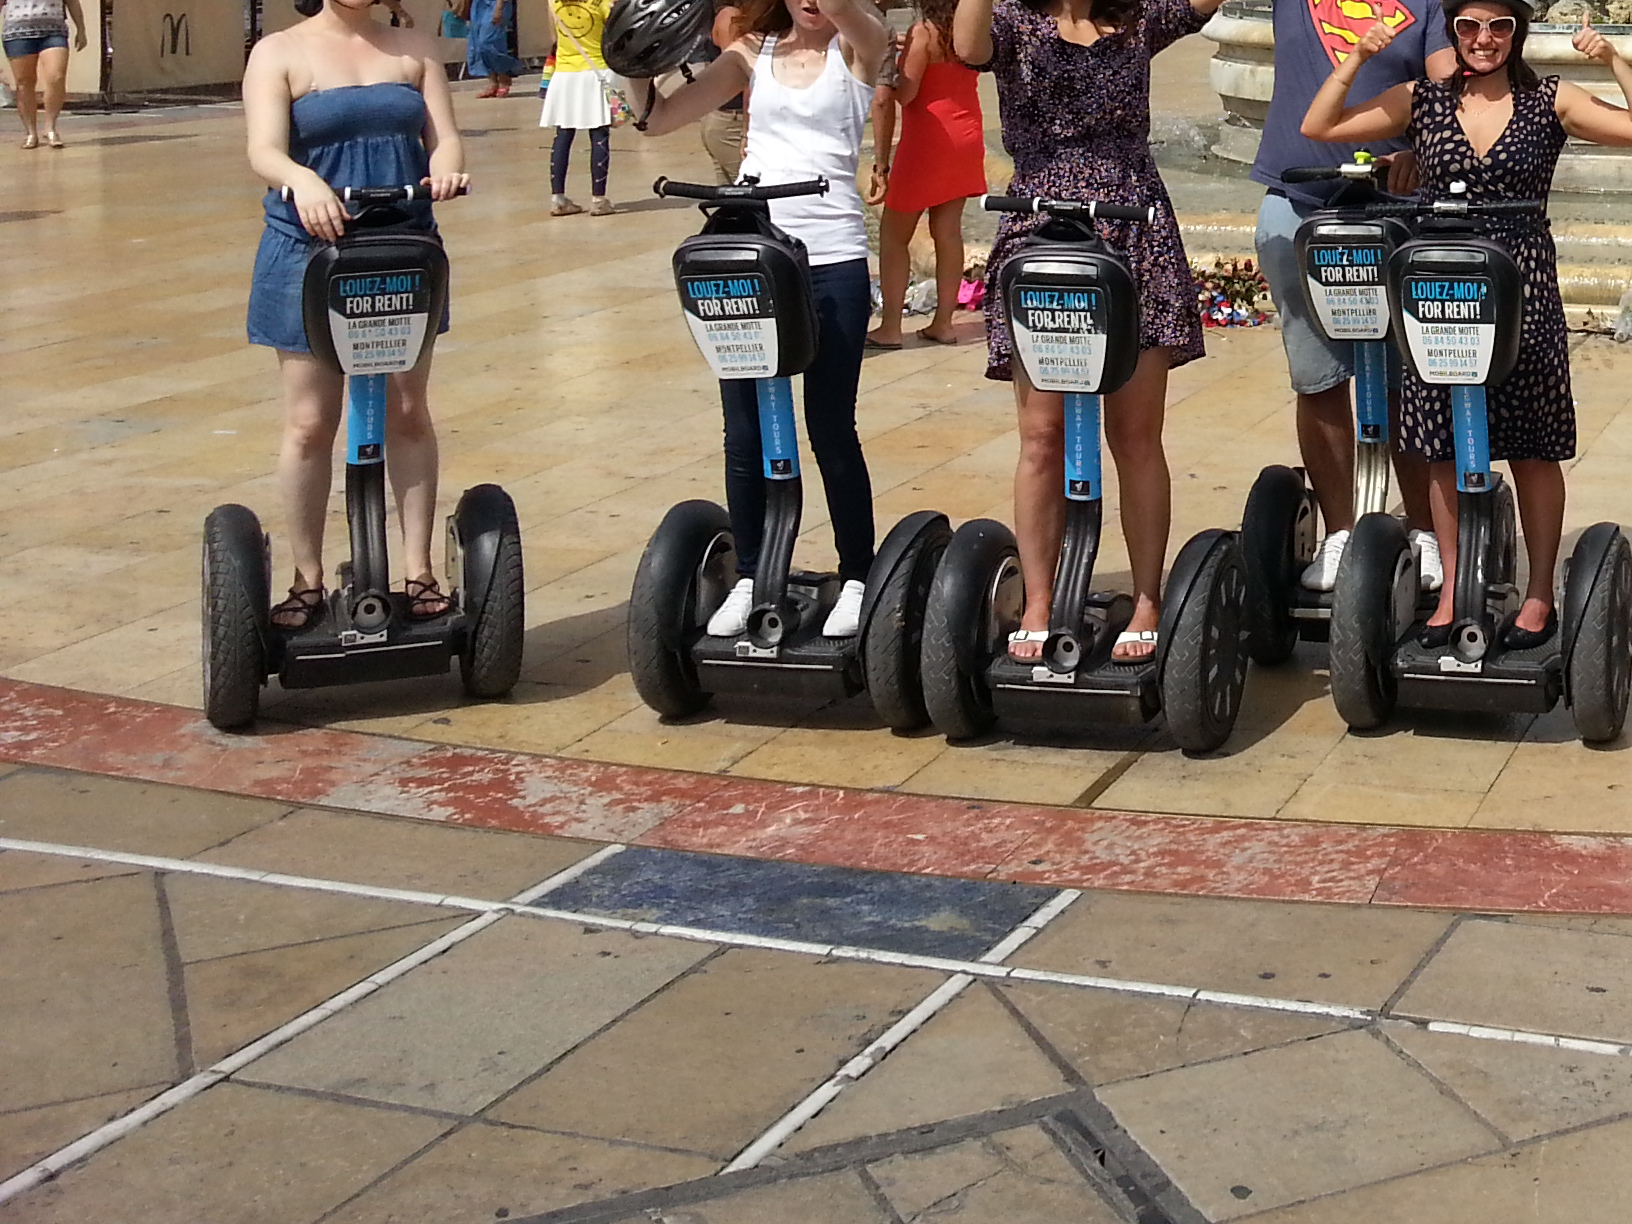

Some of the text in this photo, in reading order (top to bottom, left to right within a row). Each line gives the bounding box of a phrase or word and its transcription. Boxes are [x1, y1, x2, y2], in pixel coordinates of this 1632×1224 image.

[1314, 249, 1375, 266] LOUEZ-MOI
[1321, 266, 1378, 283] FOR RENT!
[339, 274, 412, 297] LOUEZ-MOI
[687, 278, 754, 299] LOUEZ-MOI
[1325, 288, 1378, 297] LA GRANDE MOTTE
[1411, 282, 1478, 299] LOUEZ-MOI
[345, 293, 413, 315] FOR RENT!
[697, 297, 760, 317] FOR RENT!
[1020, 291, 1088, 309] LOUEZ-MOI
[1028, 309, 1052, 328] FOR
[1331, 308, 1377, 317] MONTPELLIER
[1418, 301, 1480, 319] FOR RENT!
[347, 317, 411, 330] LA GRANDE MOTTE
[705, 321, 763, 332] LA GRANDE MOTTE
[1421, 326, 1480, 336] LA GRANDE MOTTE
[352, 337, 407, 351] MONTPELLIER
[715, 342, 764, 354] MONTPELLIER
[1427, 348, 1477, 357] MONTPELLIER
